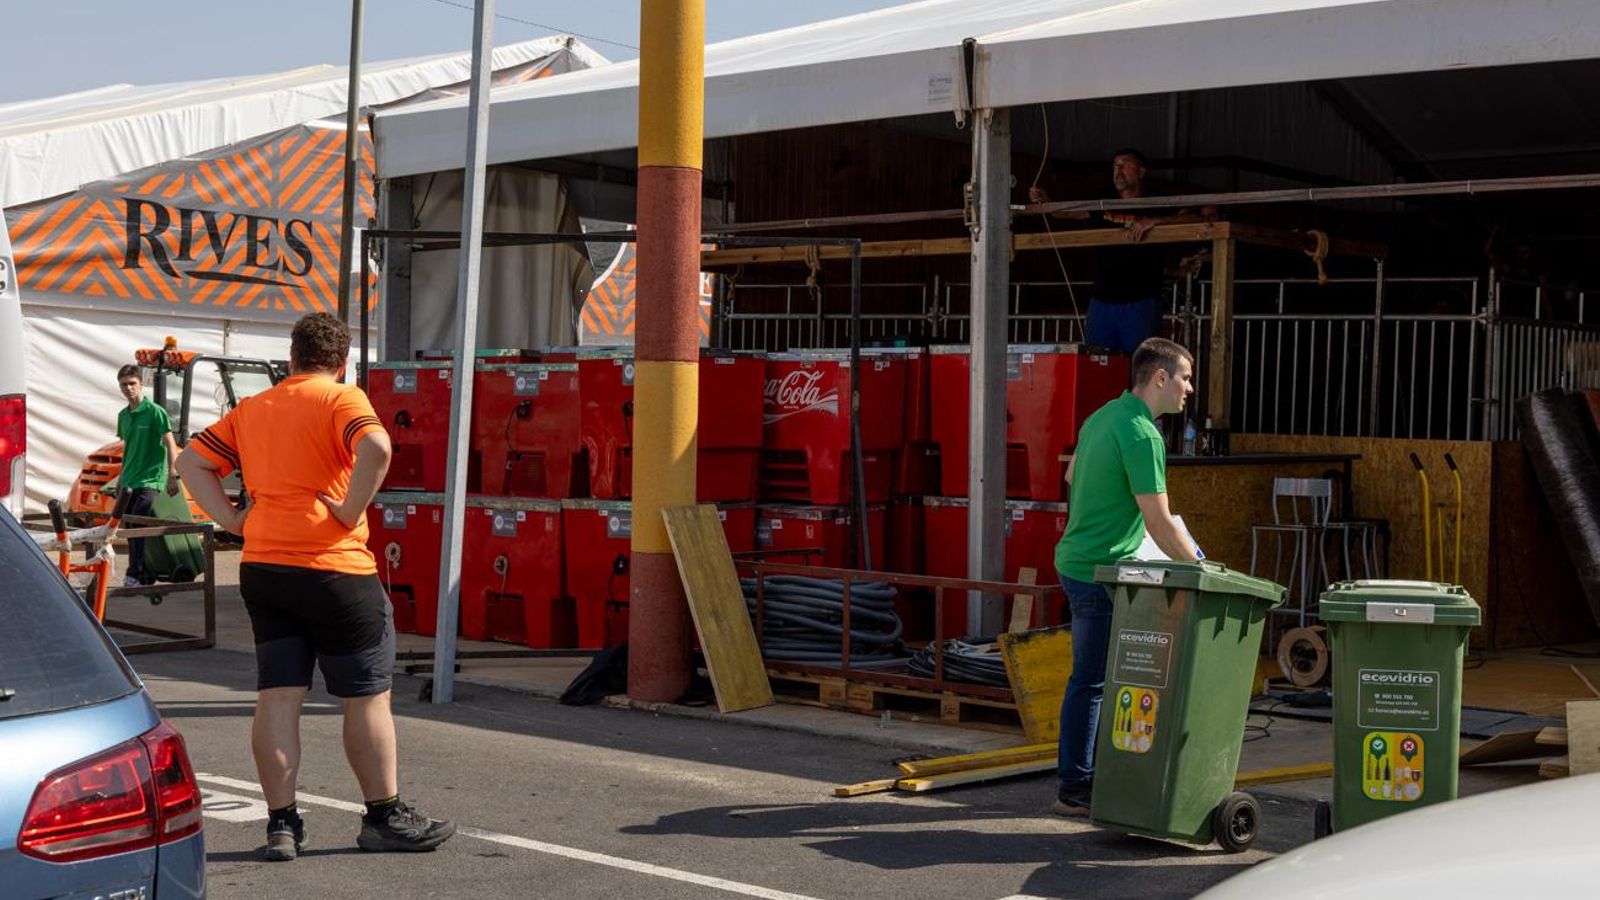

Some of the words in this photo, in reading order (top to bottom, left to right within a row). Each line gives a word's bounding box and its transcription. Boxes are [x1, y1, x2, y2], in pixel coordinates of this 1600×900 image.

[121, 197, 313, 278] RIVES
[764, 370, 826, 405] a-Cola
[1120, 633, 1168, 643] ecovidrio
[1361, 673, 1433, 683] ecovidrio
